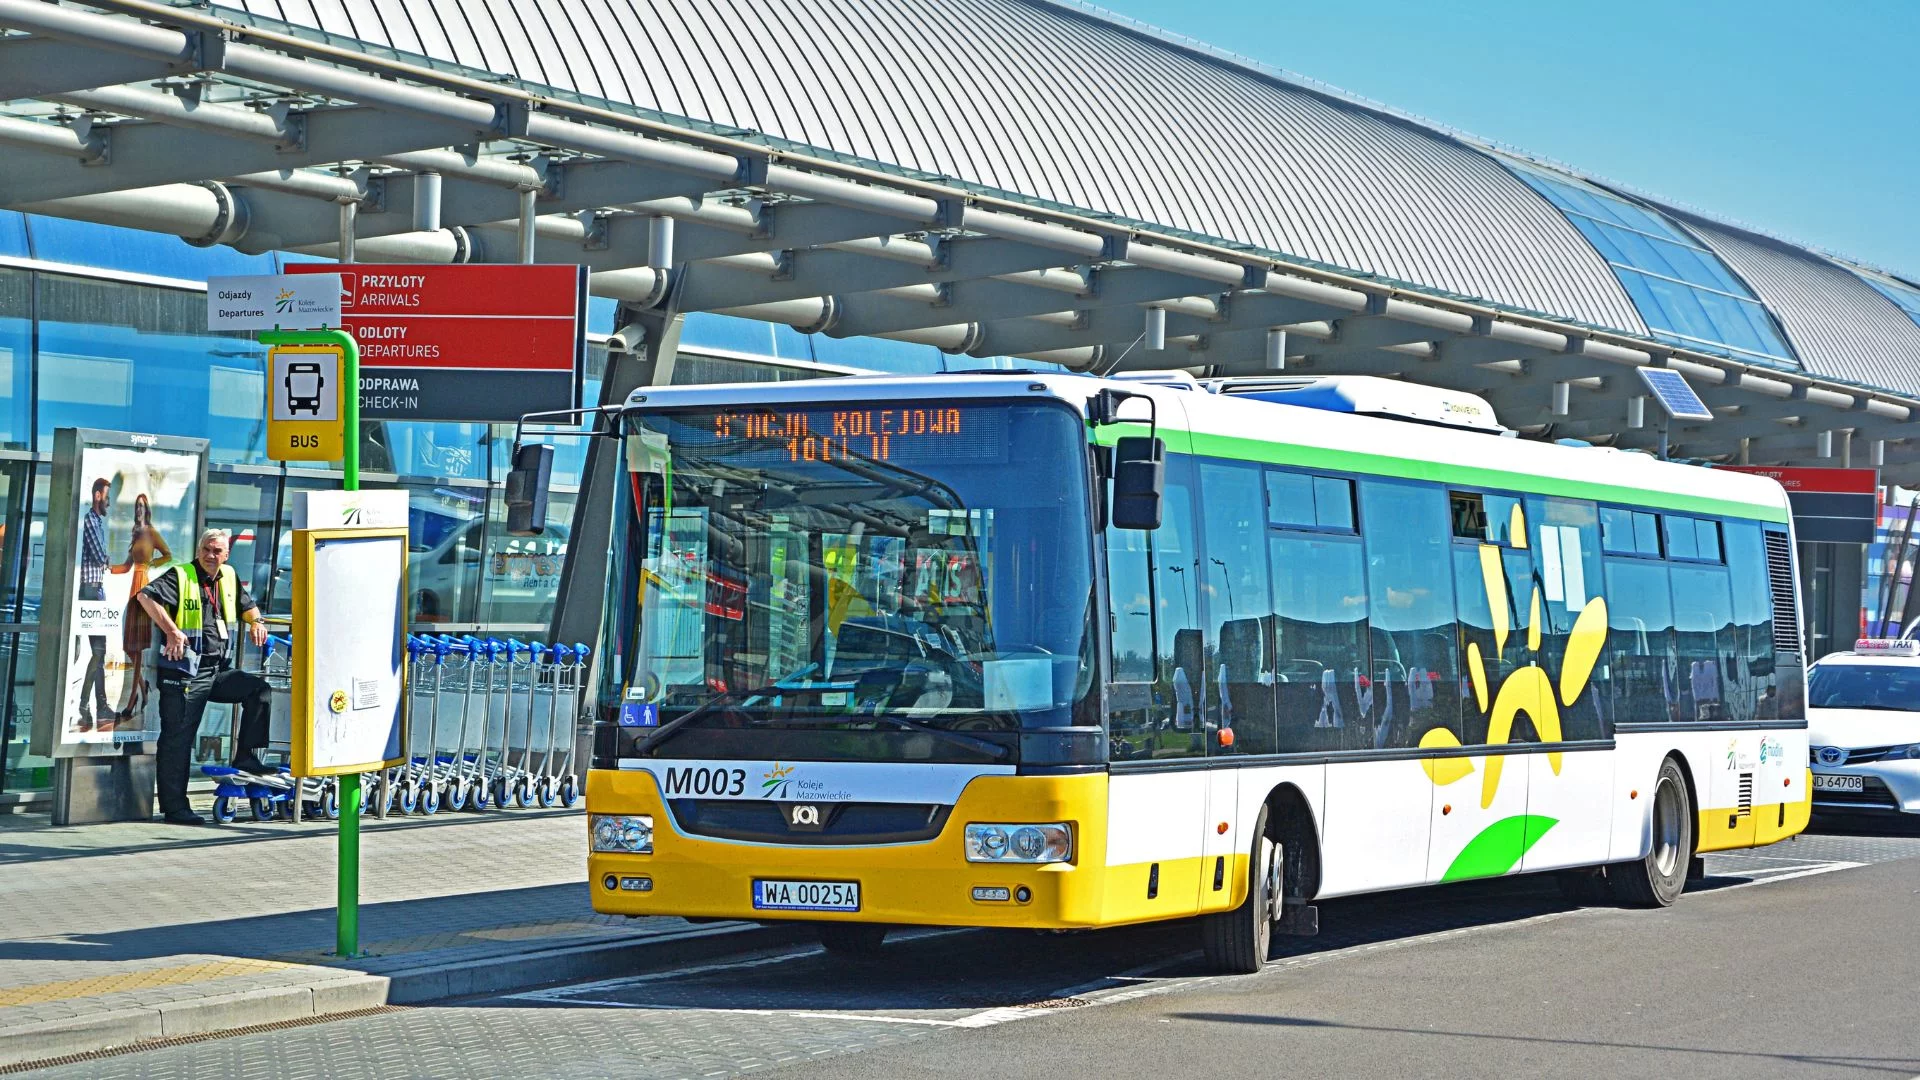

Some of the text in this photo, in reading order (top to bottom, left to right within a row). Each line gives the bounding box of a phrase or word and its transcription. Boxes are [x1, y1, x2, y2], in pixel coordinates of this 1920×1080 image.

[361, 275, 425, 288] PRZYLOTY
[218, 290, 252, 301] Odjazdy
[360, 293, 420, 306] ARRIVALS
[218, 309, 264, 319] Departures
[359, 326, 408, 339] ODLOTY
[358, 344, 440, 358] DEPARTURES
[358, 378, 420, 391] ODPRAWA
[358, 396, 418, 409] CHECK-IN
[833, 409, 960, 436] KOLEJOWA
[290, 435, 319, 448] BUS
[665, 767, 746, 796] M003
[797, 780, 824, 790] Koleje
[1827, 776, 1862, 789] 64708
[796, 791, 852, 801] Mazowieckie
[765, 883, 856, 906] WA 0025A
